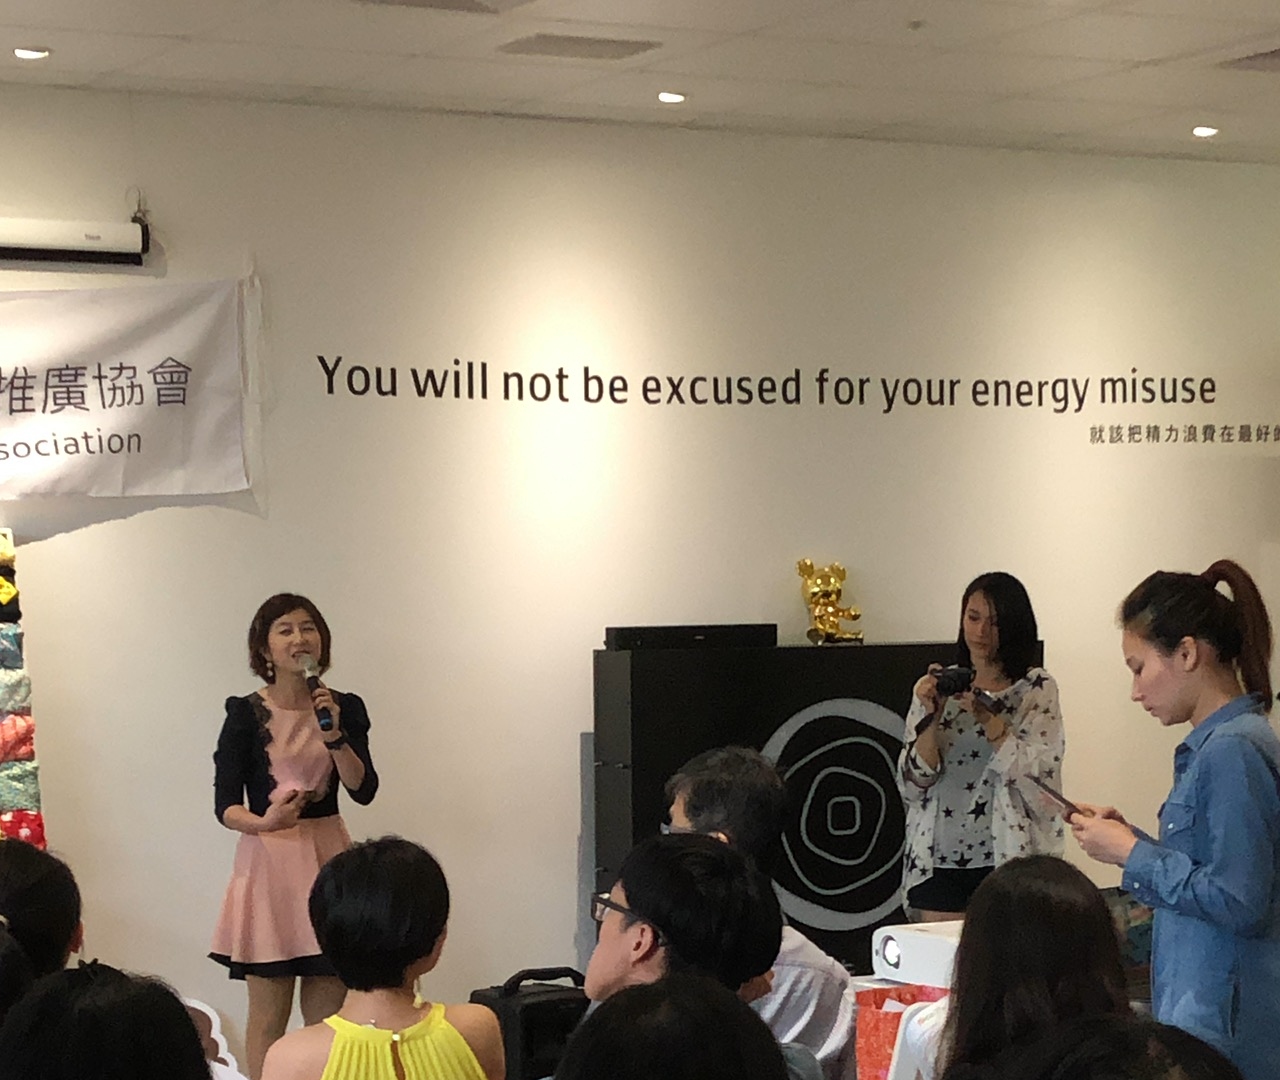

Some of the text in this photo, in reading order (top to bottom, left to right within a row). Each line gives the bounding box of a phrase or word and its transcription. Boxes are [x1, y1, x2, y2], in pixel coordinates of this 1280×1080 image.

[317, 355, 1217, 413] You will not be excused for your energy misuse
